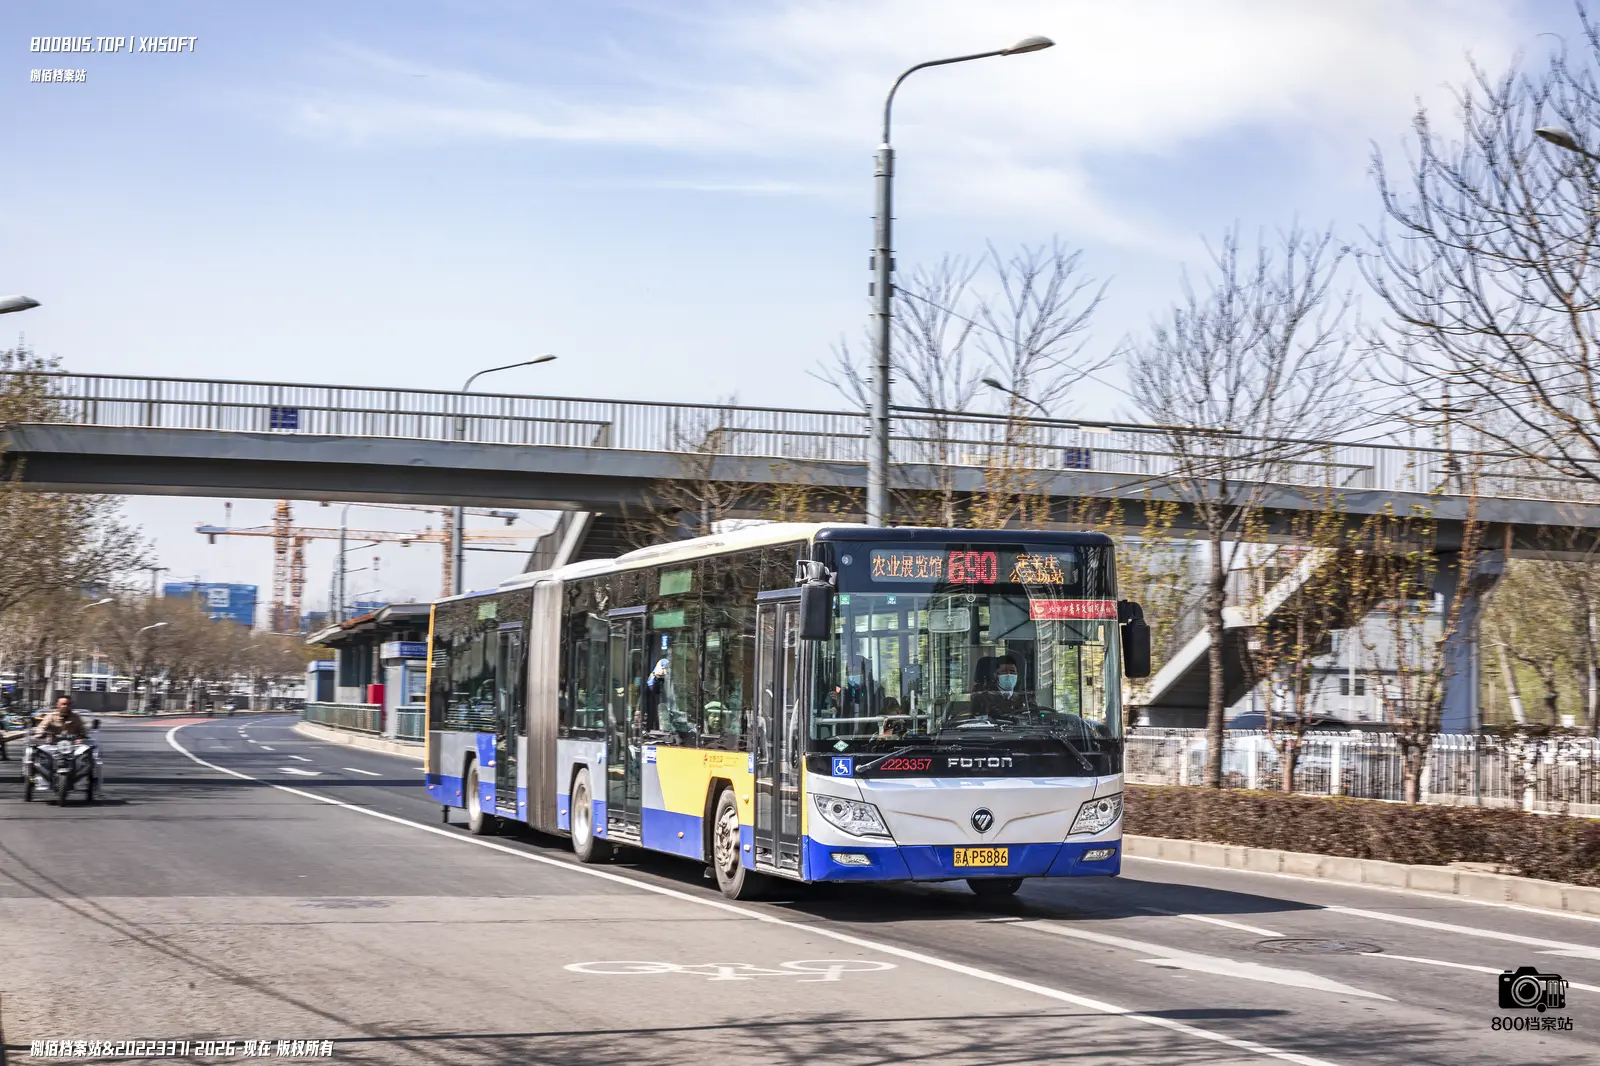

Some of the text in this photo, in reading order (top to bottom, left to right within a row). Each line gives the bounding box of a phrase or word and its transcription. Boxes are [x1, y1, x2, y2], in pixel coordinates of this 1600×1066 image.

[872, 554, 943, 579] 农业展览馆
[947, 551, 997, 585] 690
[1014, 553, 1060, 570] 定辛庄
[1008, 568, 1065, 585] 公交场站
[880, 758, 932, 771] 2223357
[947, 757, 1013, 768] FOTON
